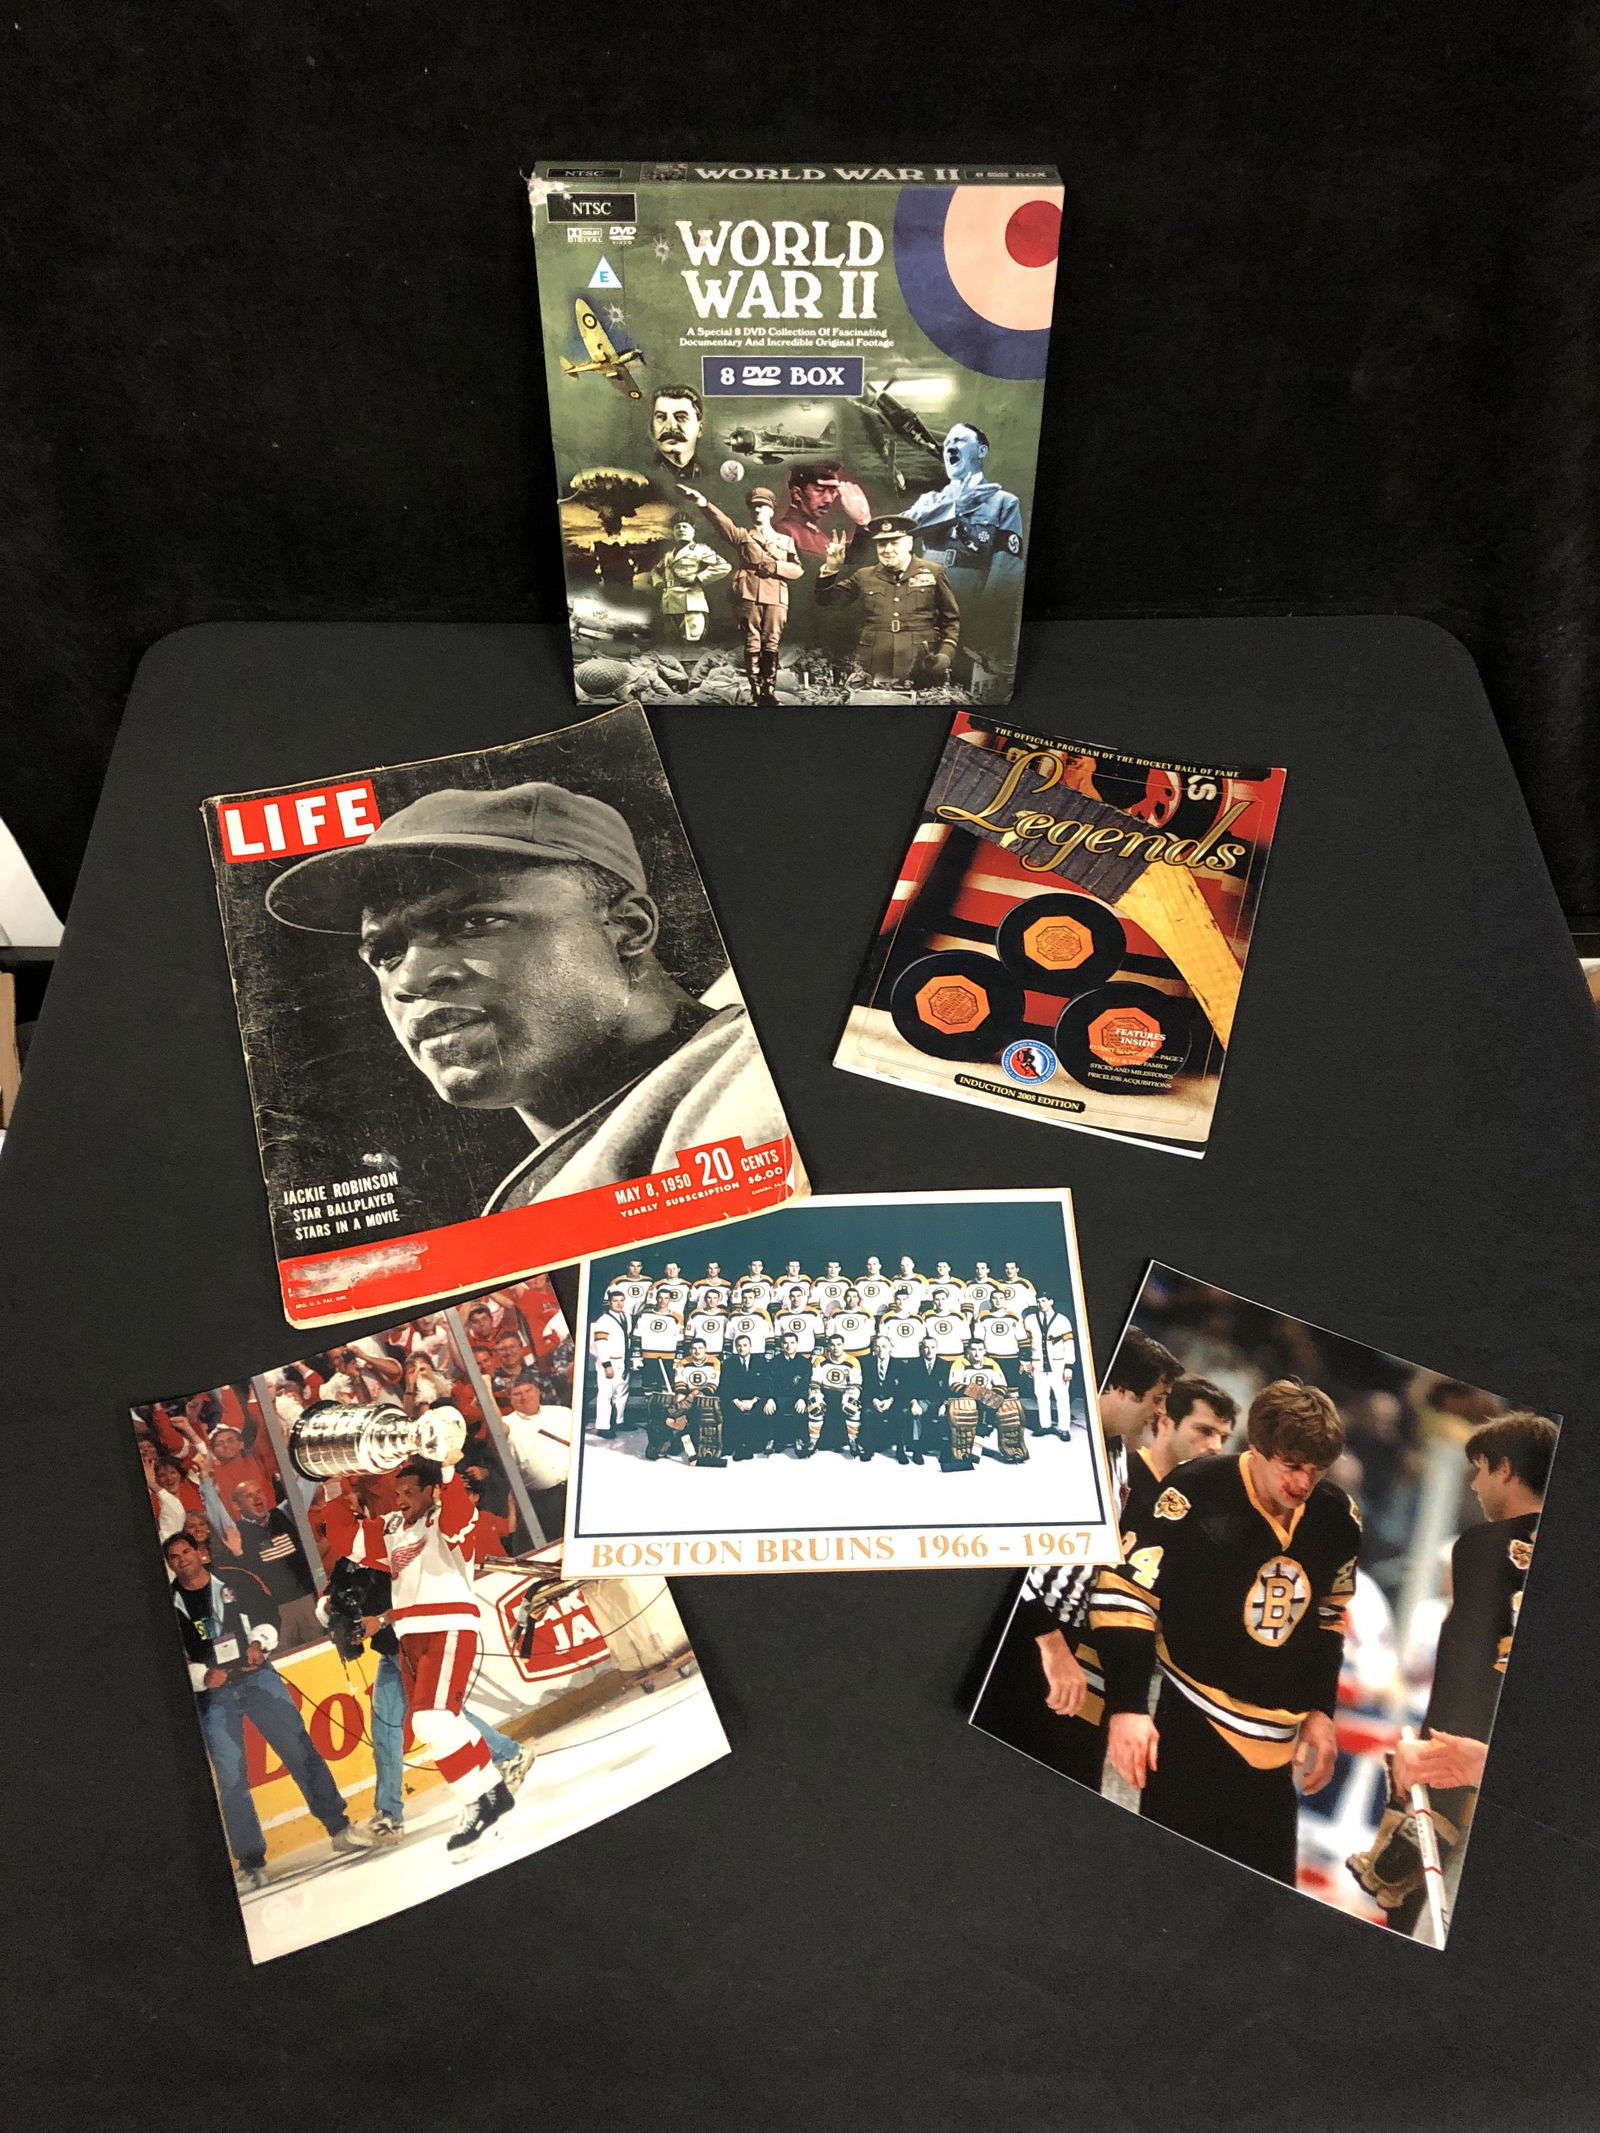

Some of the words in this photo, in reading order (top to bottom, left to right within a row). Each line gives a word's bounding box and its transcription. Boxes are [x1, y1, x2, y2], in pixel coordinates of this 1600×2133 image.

[695, 168, 826, 180] WORLD
[834, 168, 925, 181] WAR
[935, 168, 961, 181] II
[572, 202, 612, 216] NTSC
[609, 226, 637, 235] DVD
[675, 220, 884, 267] WORLD
[600, 271, 610, 283] E
[681, 270, 823, 319] WAR
[839, 270, 879, 319] II
[679, 338, 743, 348] Documentary
[745, 338, 763, 347] And
[767, 338, 814, 347] Incredible
[816, 338, 854, 348] Original
[856, 338, 895, 348] Footage
[686, 328, 695, 336] A
[697, 328, 733, 339] Special
[743, 328, 766, 336] DVD
[768, 328, 816, 337] Collection
[818, 328, 830, 337] Of
[832, 329, 888, 338] Fascinating
[720, 367, 735, 385] 8
[790, 367, 845, 385] BOX
[995, 726, 1013, 737] THE
[1014, 732, 1055, 748] OFFICIAL
[1056, 743, 1100, 758] PROGRAM
[1102, 752, 1116, 761] OF
[1116, 754, 1135, 764] THE
[1136, 758, 1173, 771] HOCKEY
[1174, 764, 1198, 774] HALL
[1200, 767, 1214, 775] OF
[1215, 769, 1241, 779] FAME
[225, 787, 376, 856] LIFE
[934, 751, 1253, 872] Legends
[1115, 1027, 1167, 1041] FEATURES
[1120, 1037, 1158, 1048] INSIDE
[1130, 1069, 1174, 1080] MILESTONES
[959, 1076, 1016, 1098] INDUCTION
[1017, 1091, 1037, 1102] 2005
[1037, 1096, 1080, 1111] EDITION
[283, 1186, 327, 1205] JACKIE
[333, 1171, 399, 1198] ROBINSON
[614, 1185, 641, 1205] MAY
[645, 1182, 660, 1198] 8,
[661, 1173, 692, 1194] 1950
[694, 1147, 735, 1187] 20
[740, 1149, 780, 1172] CENTS
[292, 1206, 322, 1222] STAR
[327, 1192, 395, 1217] BALLPLAYER
[620, 1202, 659, 1218] YEARLY
[665, 1182, 740, 1207] SUBSCRIPTION
[748, 1166, 783, 1184] $6.00
[295, 1223, 331, 1241] STARS
[336, 1221, 349, 1234] IN
[353, 1217, 362, 1231] A
[365, 1209, 400, 1228] MOVIE
[591, 1540, 742, 1568] BOSTON
[757, 1536, 895, 1563] BRUINS
[917, 1534, 988, 1558] 1966
[1023, 1532, 1091, 1556] 1967
